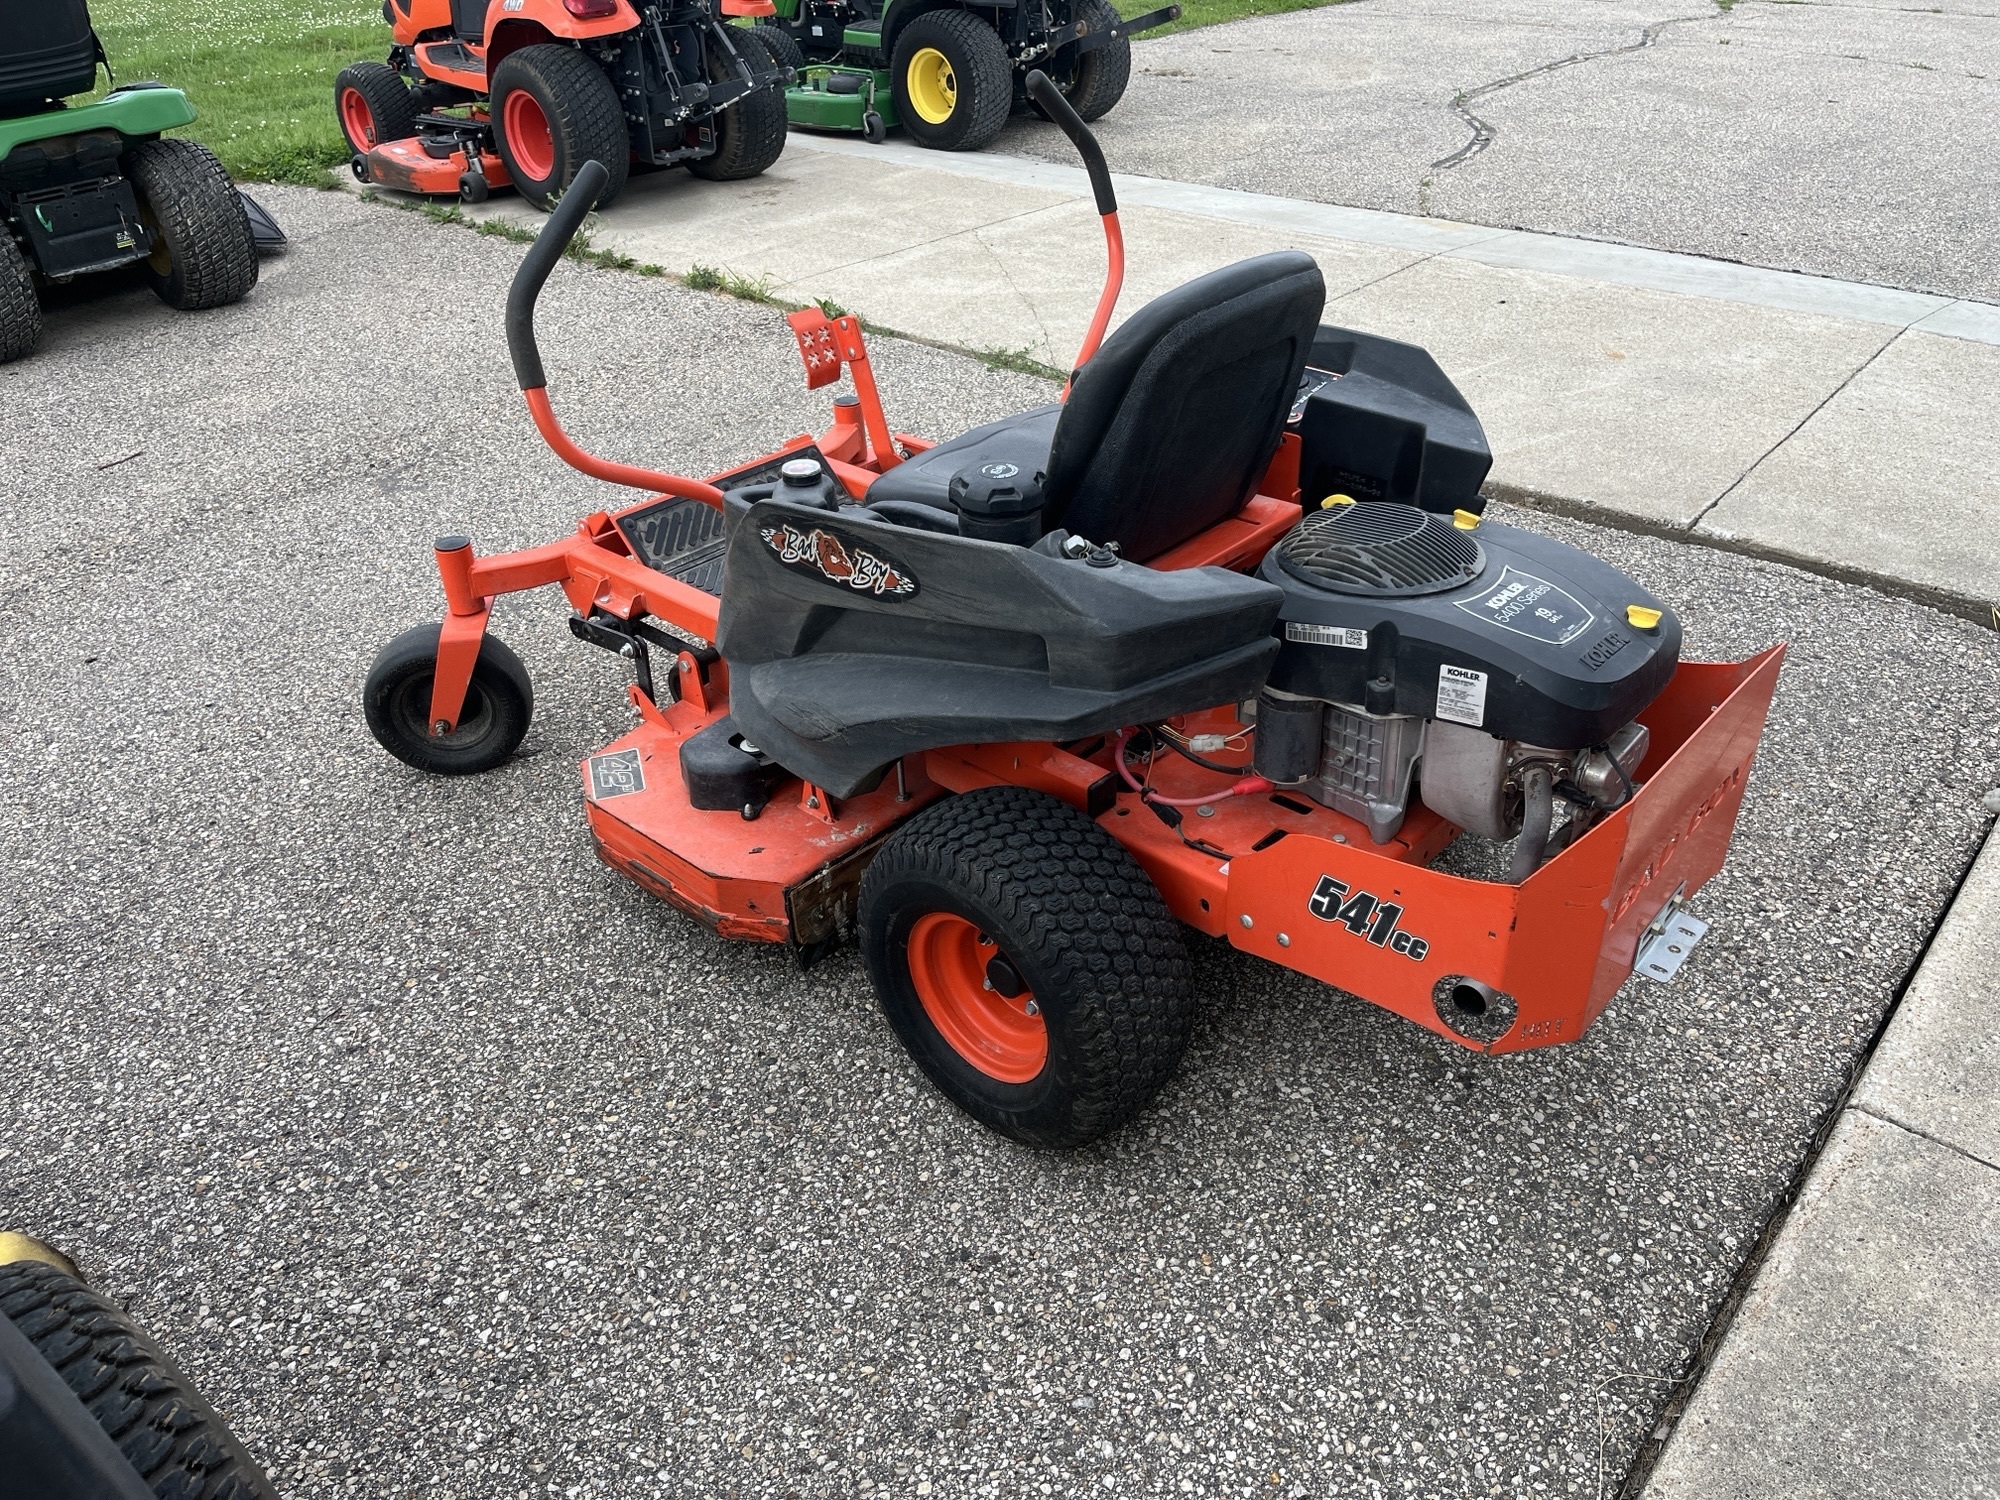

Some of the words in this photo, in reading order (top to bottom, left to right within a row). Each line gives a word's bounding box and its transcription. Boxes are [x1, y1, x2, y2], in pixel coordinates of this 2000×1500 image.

[850, 549, 890, 595] Boy
[1485, 582, 1529, 610] KOHLER
[1494, 602, 1525, 622] 5400
[1517, 584, 1550, 605] Series
[1534, 607, 1552, 619] 19
[1579, 632, 1632, 672] KOHLER
[1447, 668, 1480, 681] KOHLER
